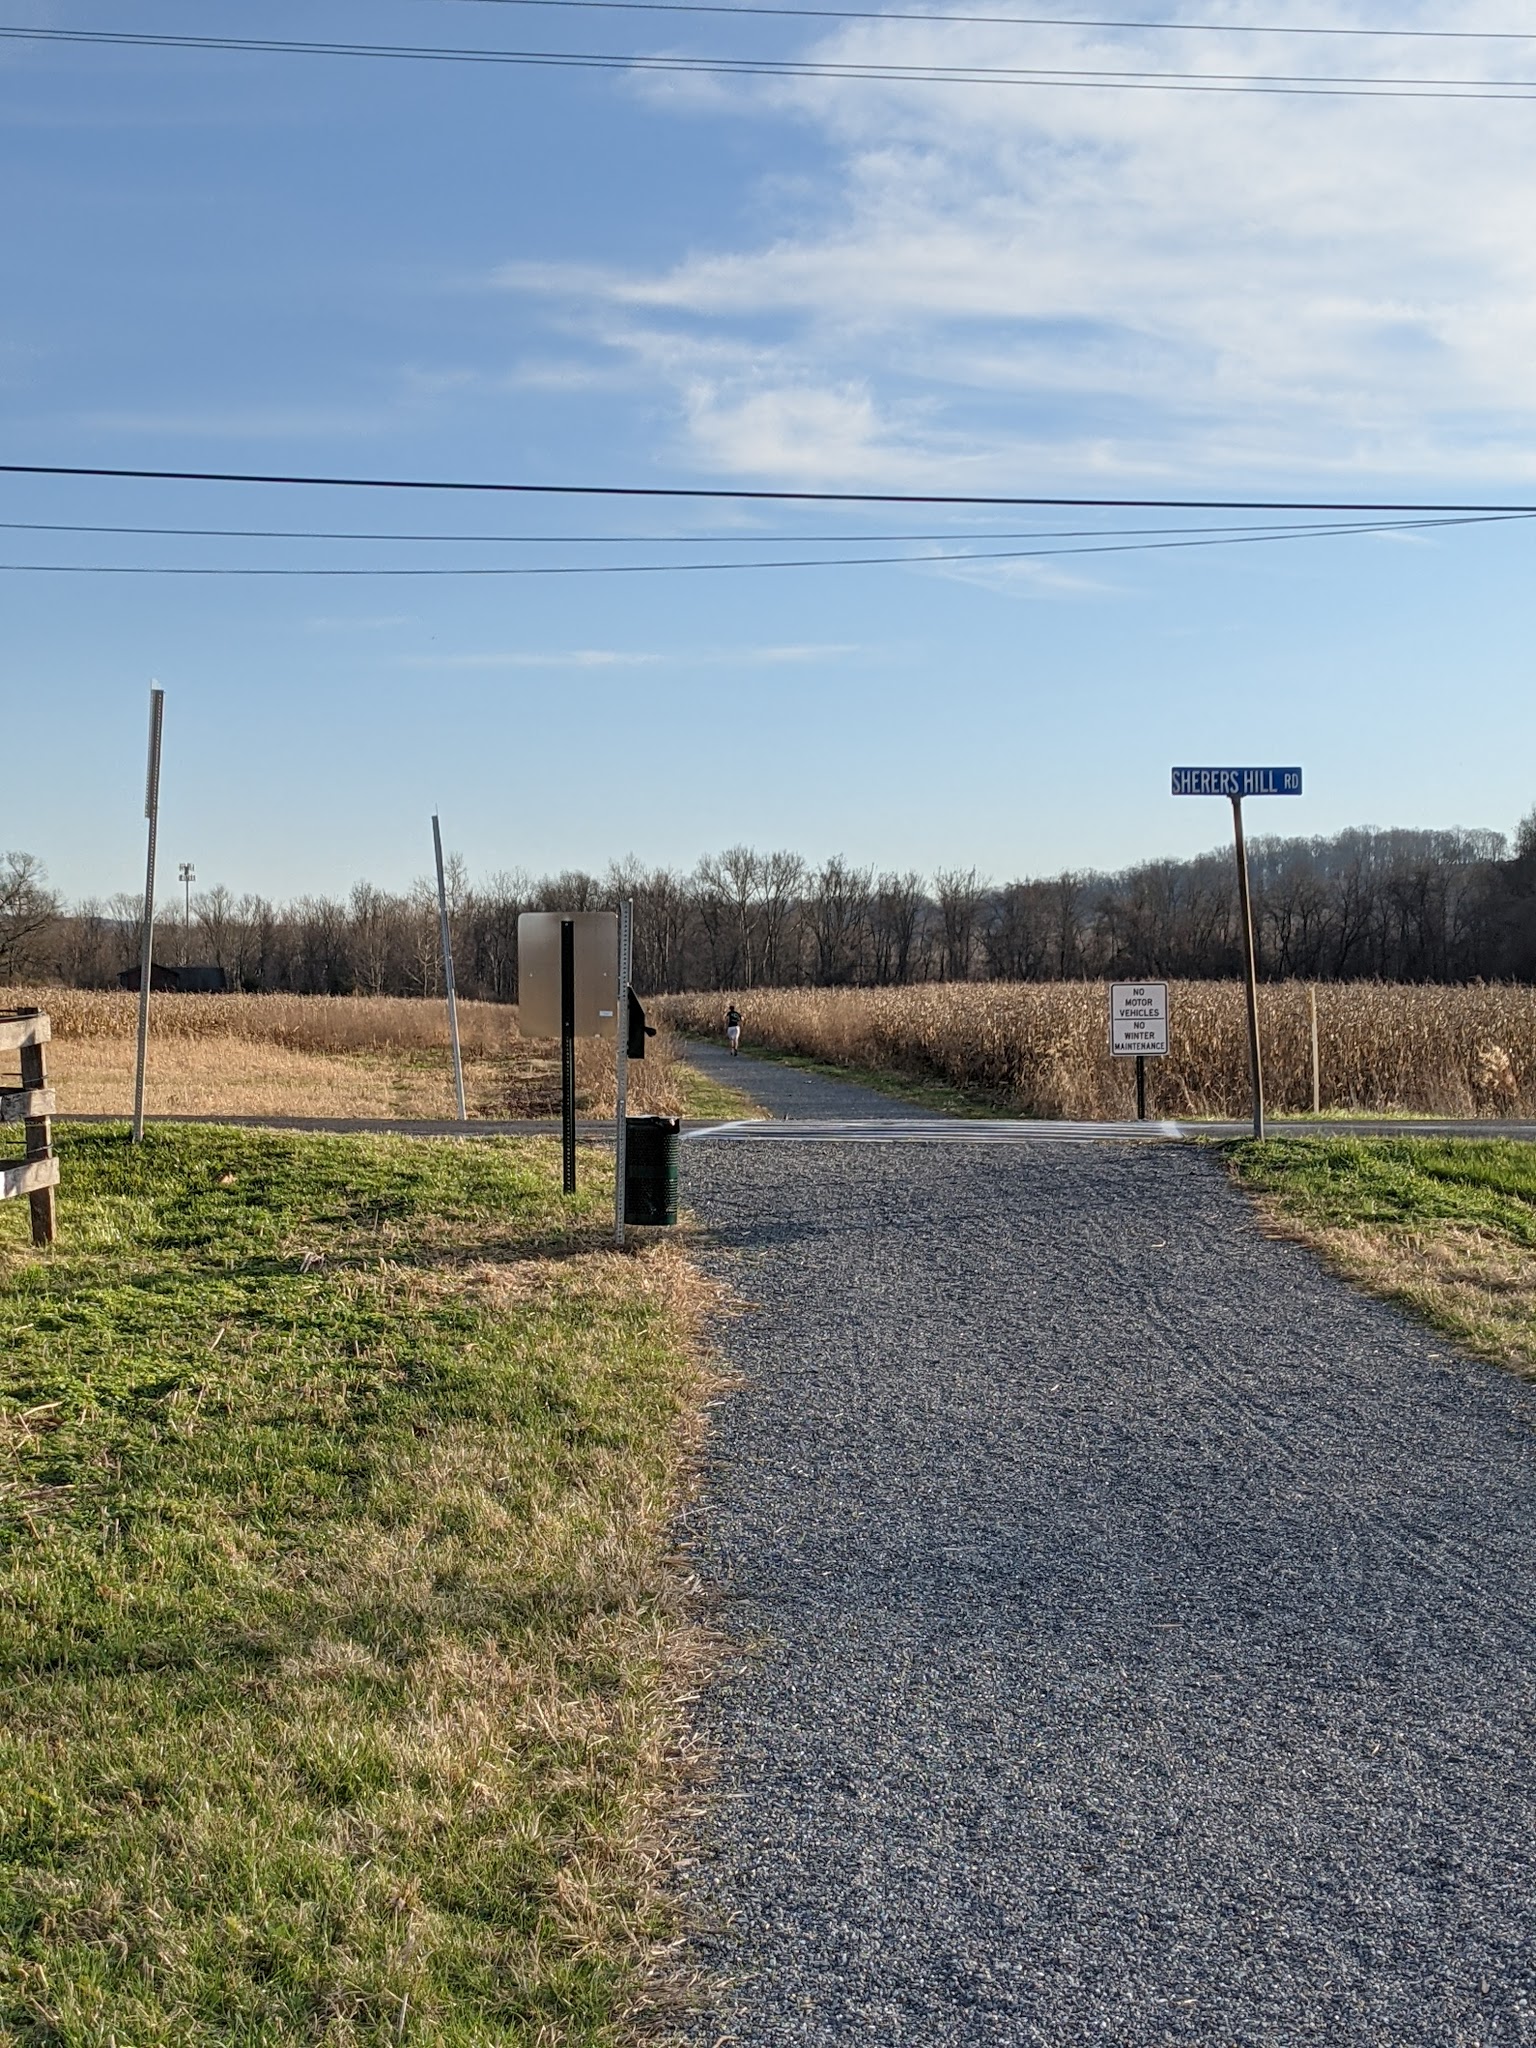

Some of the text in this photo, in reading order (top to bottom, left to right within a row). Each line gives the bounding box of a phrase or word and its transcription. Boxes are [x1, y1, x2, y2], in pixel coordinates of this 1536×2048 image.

[1172, 770, 1299, 793] SHERERS HILL RD
[1133, 988, 1145, 996] NO
[1125, 998, 1153, 1007] MOTOR
[1119, 1008, 1160, 1017] VEHICLES
[1133, 1021, 1146, 1030] NO
[1124, 1031, 1155, 1040] WINTER
[1114, 1042, 1165, 1051] MAINTENANCE
